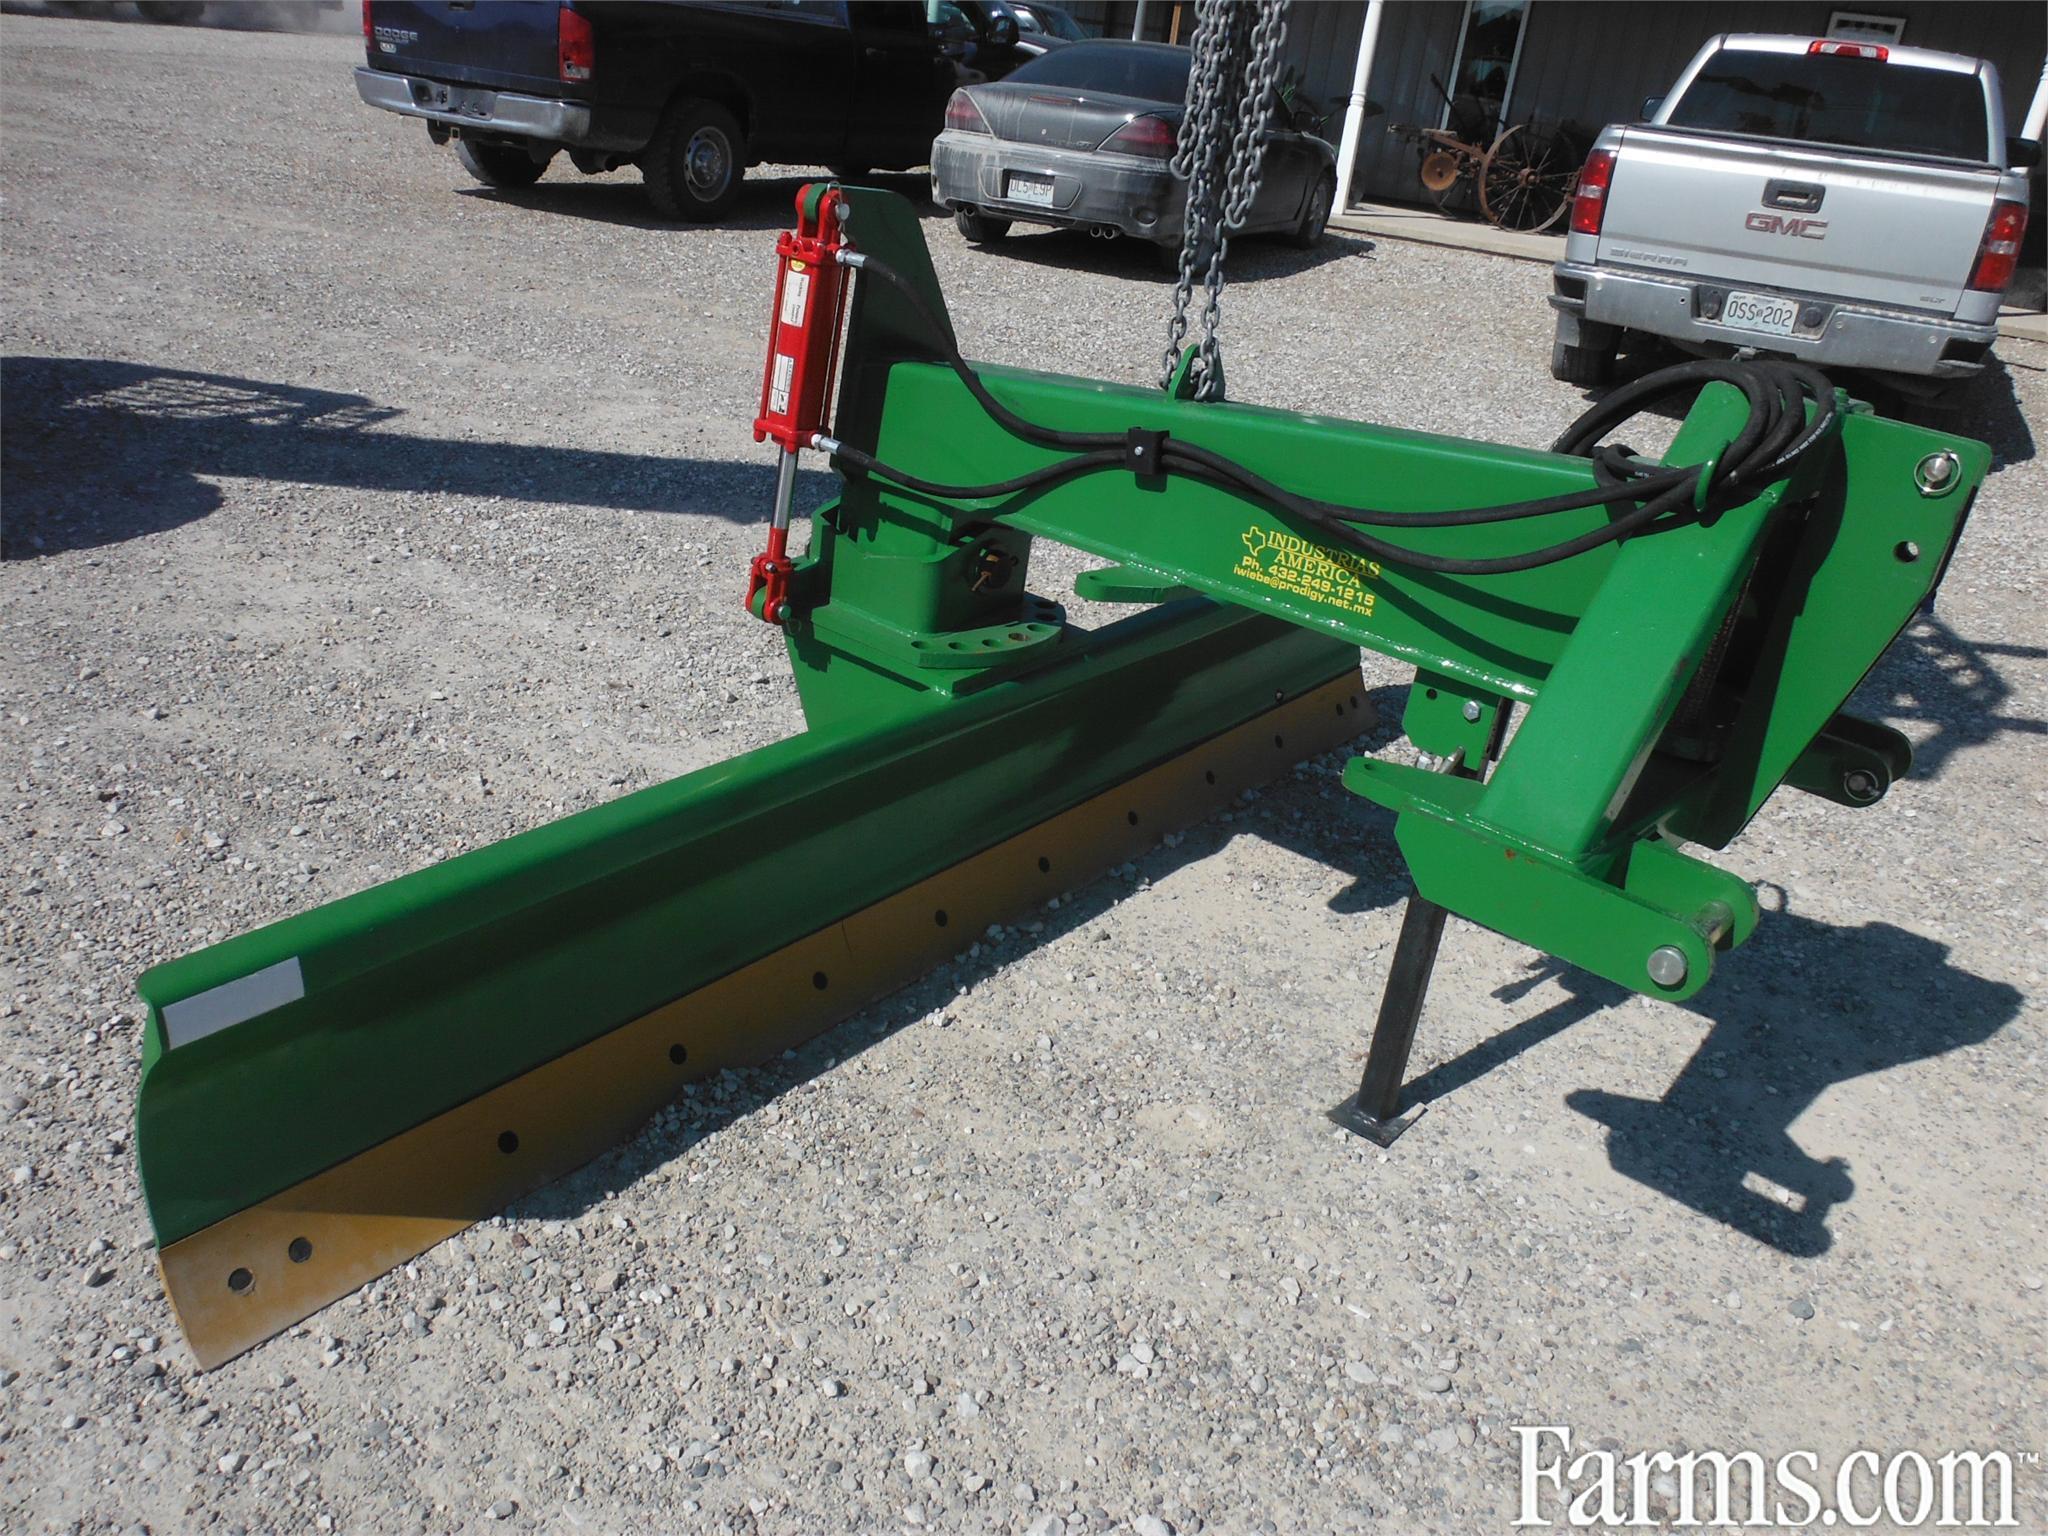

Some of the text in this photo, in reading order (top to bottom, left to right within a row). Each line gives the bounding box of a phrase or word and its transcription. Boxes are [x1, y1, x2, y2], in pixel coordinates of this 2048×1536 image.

[374, 25, 418, 41] DODGE
[1745, 211, 1829, 240] GMC
[1762, 306, 1793, 328] 202
[1242, 555, 1263, 572] Ph.
[1267, 530, 1380, 577] INDUSTRIAS
[1274, 549, 1361, 589] AMERICA
